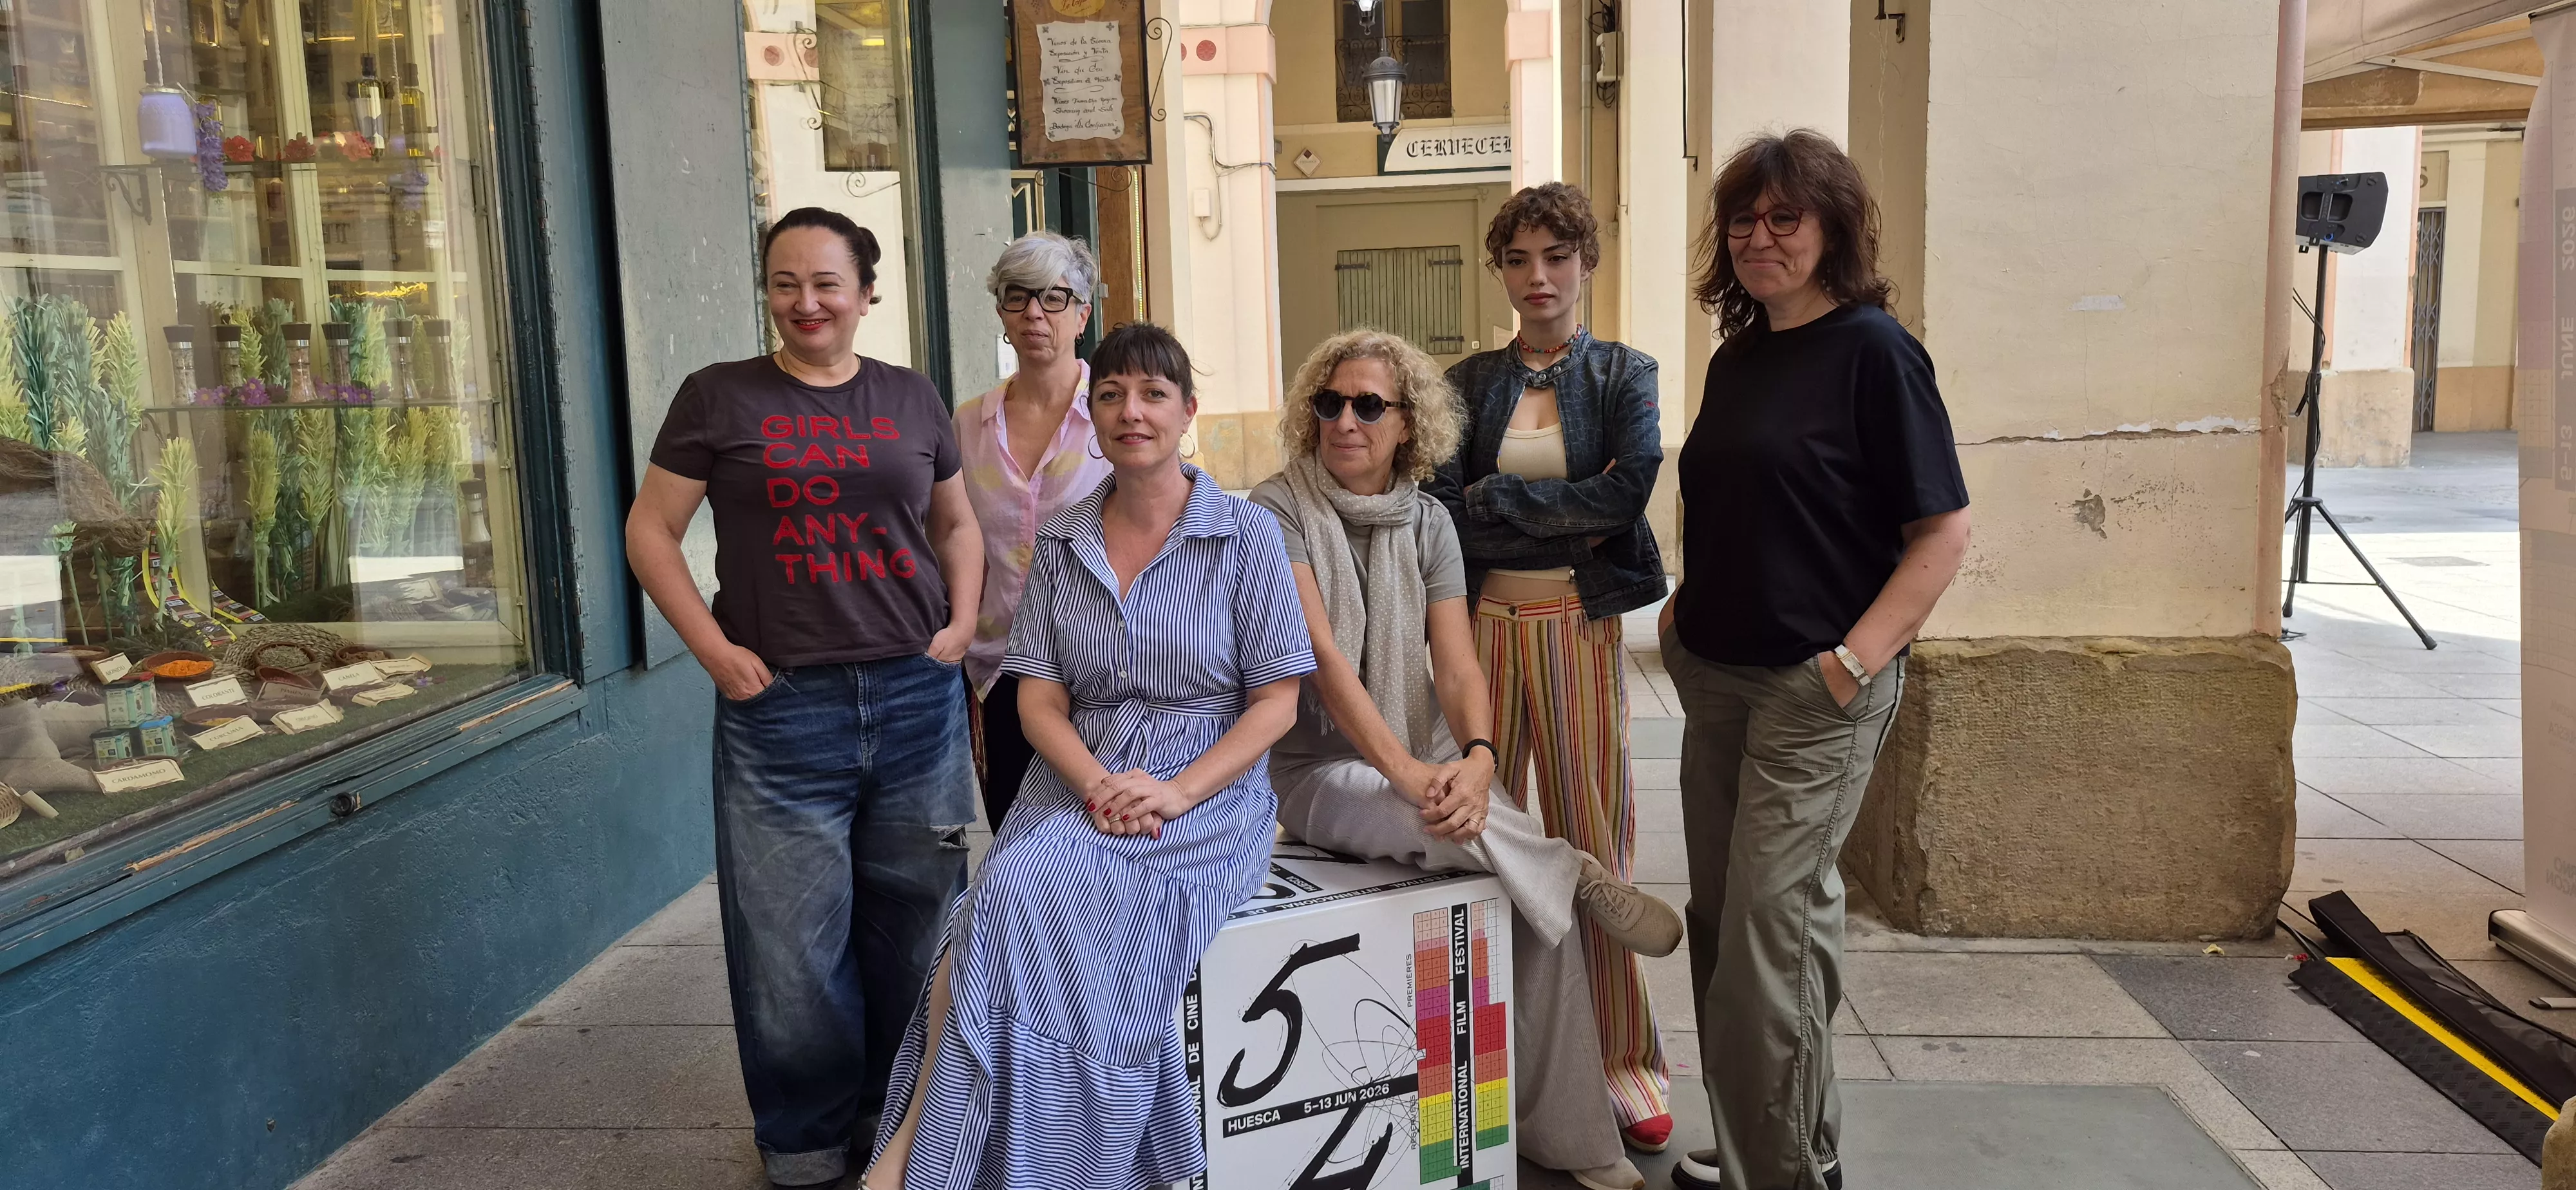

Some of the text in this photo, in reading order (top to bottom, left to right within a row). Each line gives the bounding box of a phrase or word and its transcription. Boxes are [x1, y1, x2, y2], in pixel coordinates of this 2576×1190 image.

[1047, 37, 1066, 46] Vinos
[1080, 36, 1088, 45] la
[1052, 63, 1103, 75] Vin du Cru
[761, 414, 900, 440] GIRLS
[763, 442, 870, 469] CAN
[766, 475, 840, 508] DO
[773, 513, 887, 546] ANY-
[775, 547, 917, 584] THING
[338, 672, 361, 681] CANELA
[112, 768, 166, 784] CARDAMOMO
[1285, 875, 1317, 892] HUESCA
[1389, 874, 1450, 888] FESTIVAL
[1276, 887, 1381, 909] INTERNACIONAL
[1248, 908, 1267, 916] DE
[1186, 994, 1199, 1030] CINE
[1454, 908, 1470, 1169] INTERNATIONAL FILM FESTIVAL
[1188, 1041, 1200, 1064] DE
[1227, 1083, 1390, 1133] HUESCA 5-13 JUN 2026
